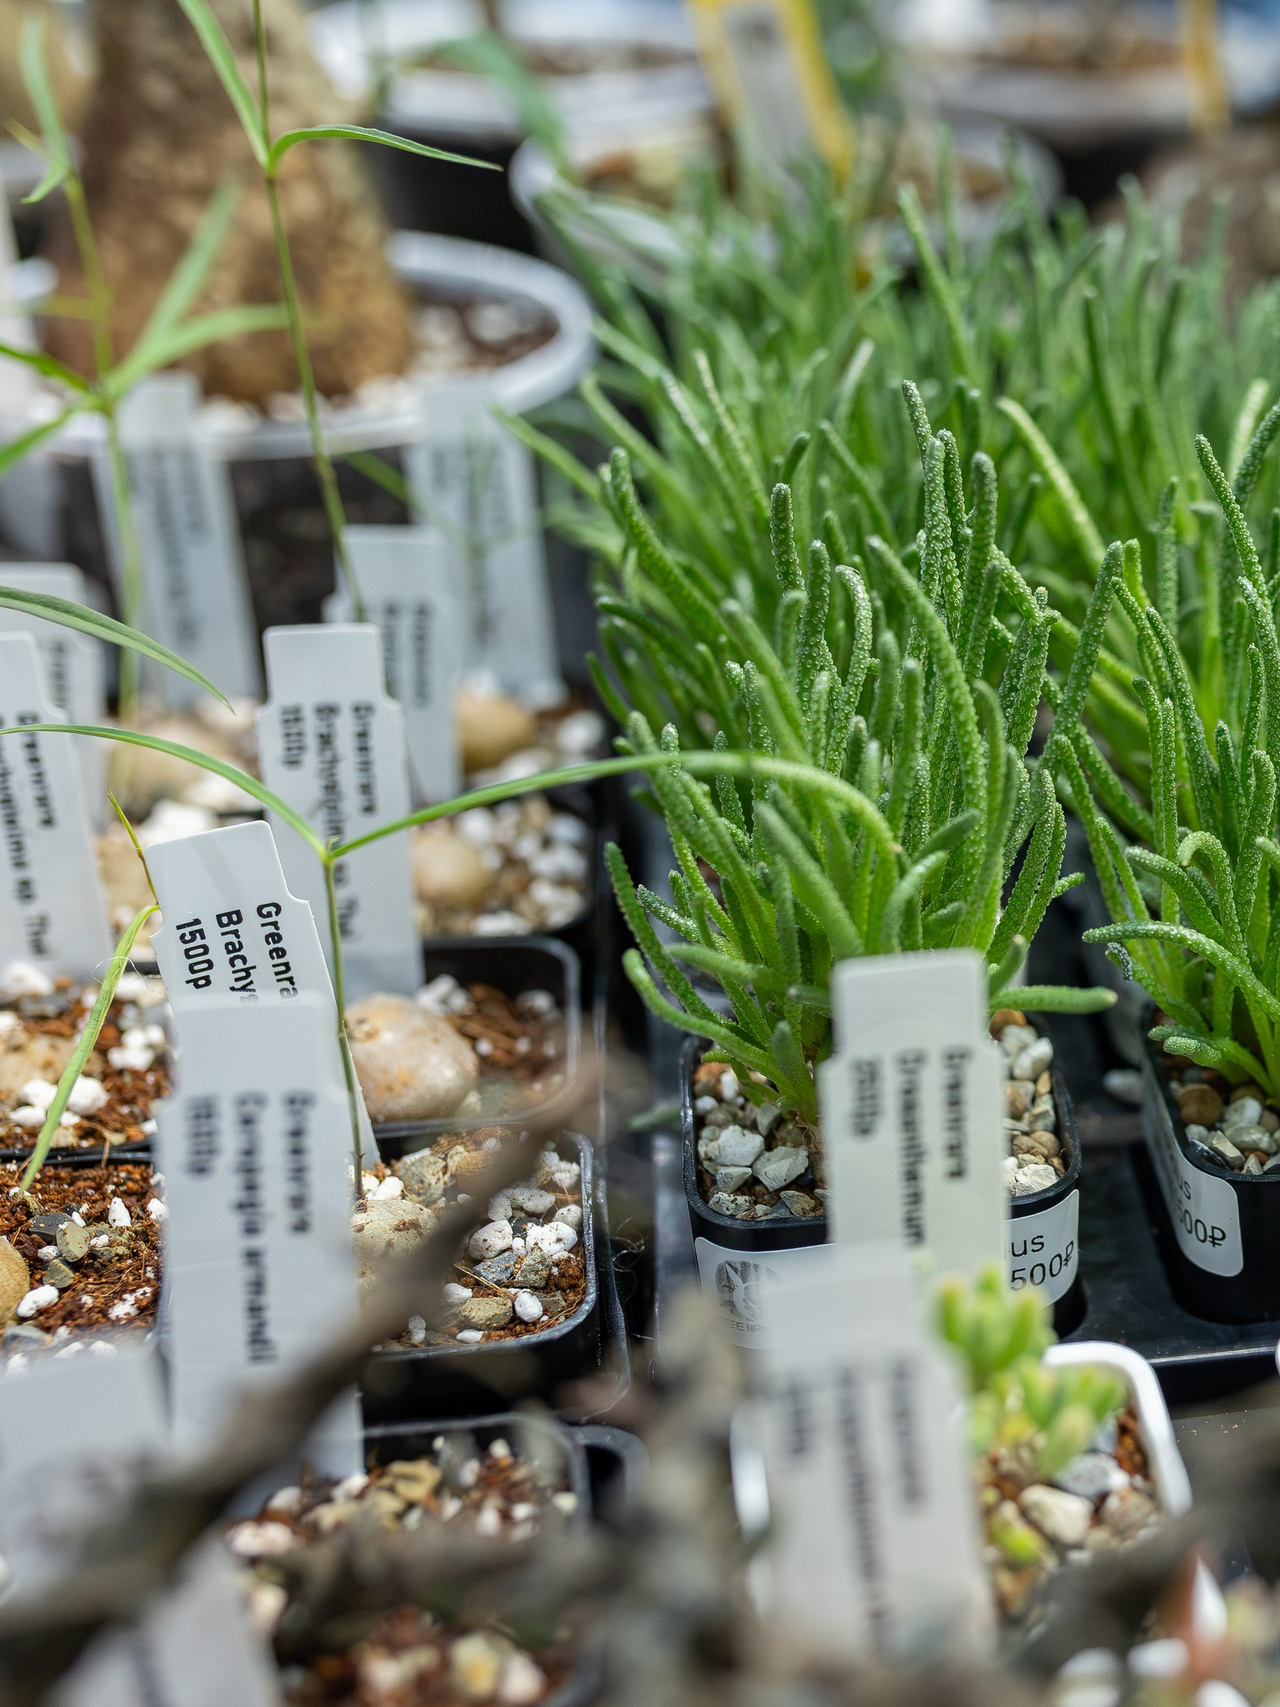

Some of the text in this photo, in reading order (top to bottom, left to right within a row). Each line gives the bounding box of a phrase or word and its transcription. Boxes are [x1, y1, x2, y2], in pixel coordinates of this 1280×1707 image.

[176, 917, 215, 991] 1500p
[216, 909, 259, 1001] Brachys
[257, 902, 301, 1001] Greenra
[1010, 1240, 1074, 1292] 500₽
